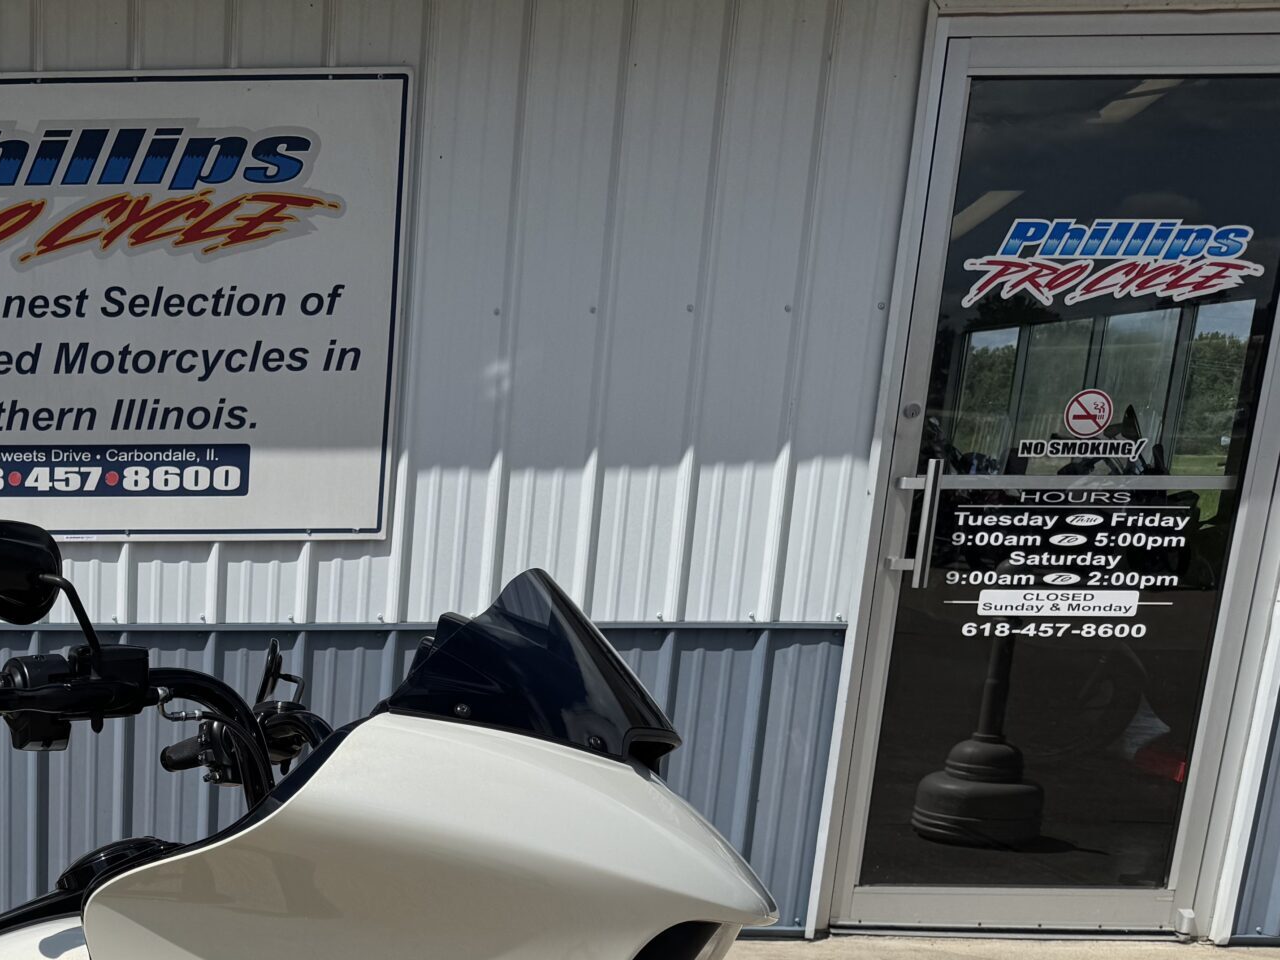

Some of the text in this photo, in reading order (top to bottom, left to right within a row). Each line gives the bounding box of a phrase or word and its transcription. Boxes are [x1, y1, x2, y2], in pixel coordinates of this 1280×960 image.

[19, 188, 342, 264] CYCLE
[997, 218, 1255, 262] Phillips
[965, 258, 1264, 306] PRO CYCLE
[100, 285, 289, 319] Selection
[299, 283, 346, 318] of
[53, 339, 311, 383] Motorcycles
[323, 339, 362, 372] in
[110, 398, 258, 431] Illinois.
[51, 449, 92, 462] Drive
[106, 448, 200, 463] Carbondale,
[1020, 438, 1147, 461] NO SMOKING!
[1020, 491, 1132, 503] HOURS
[954, 511, 1059, 529] Tuesday
[1110, 512, 1190, 530] Friday
[951, 532, 1041, 546] 9:00am
[1094, 533, 1186, 550] 5:00pm
[1008, 551, 1122, 569] Saturday
[945, 571, 1035, 586] 9:00am
[1087, 572, 1179, 589] 2:00pm
[1023, 592, 1095, 601] CLOSED
[981, 602, 1133, 613] Sunday & Monday
[961, 622, 1147, 638] 618-457-8600
